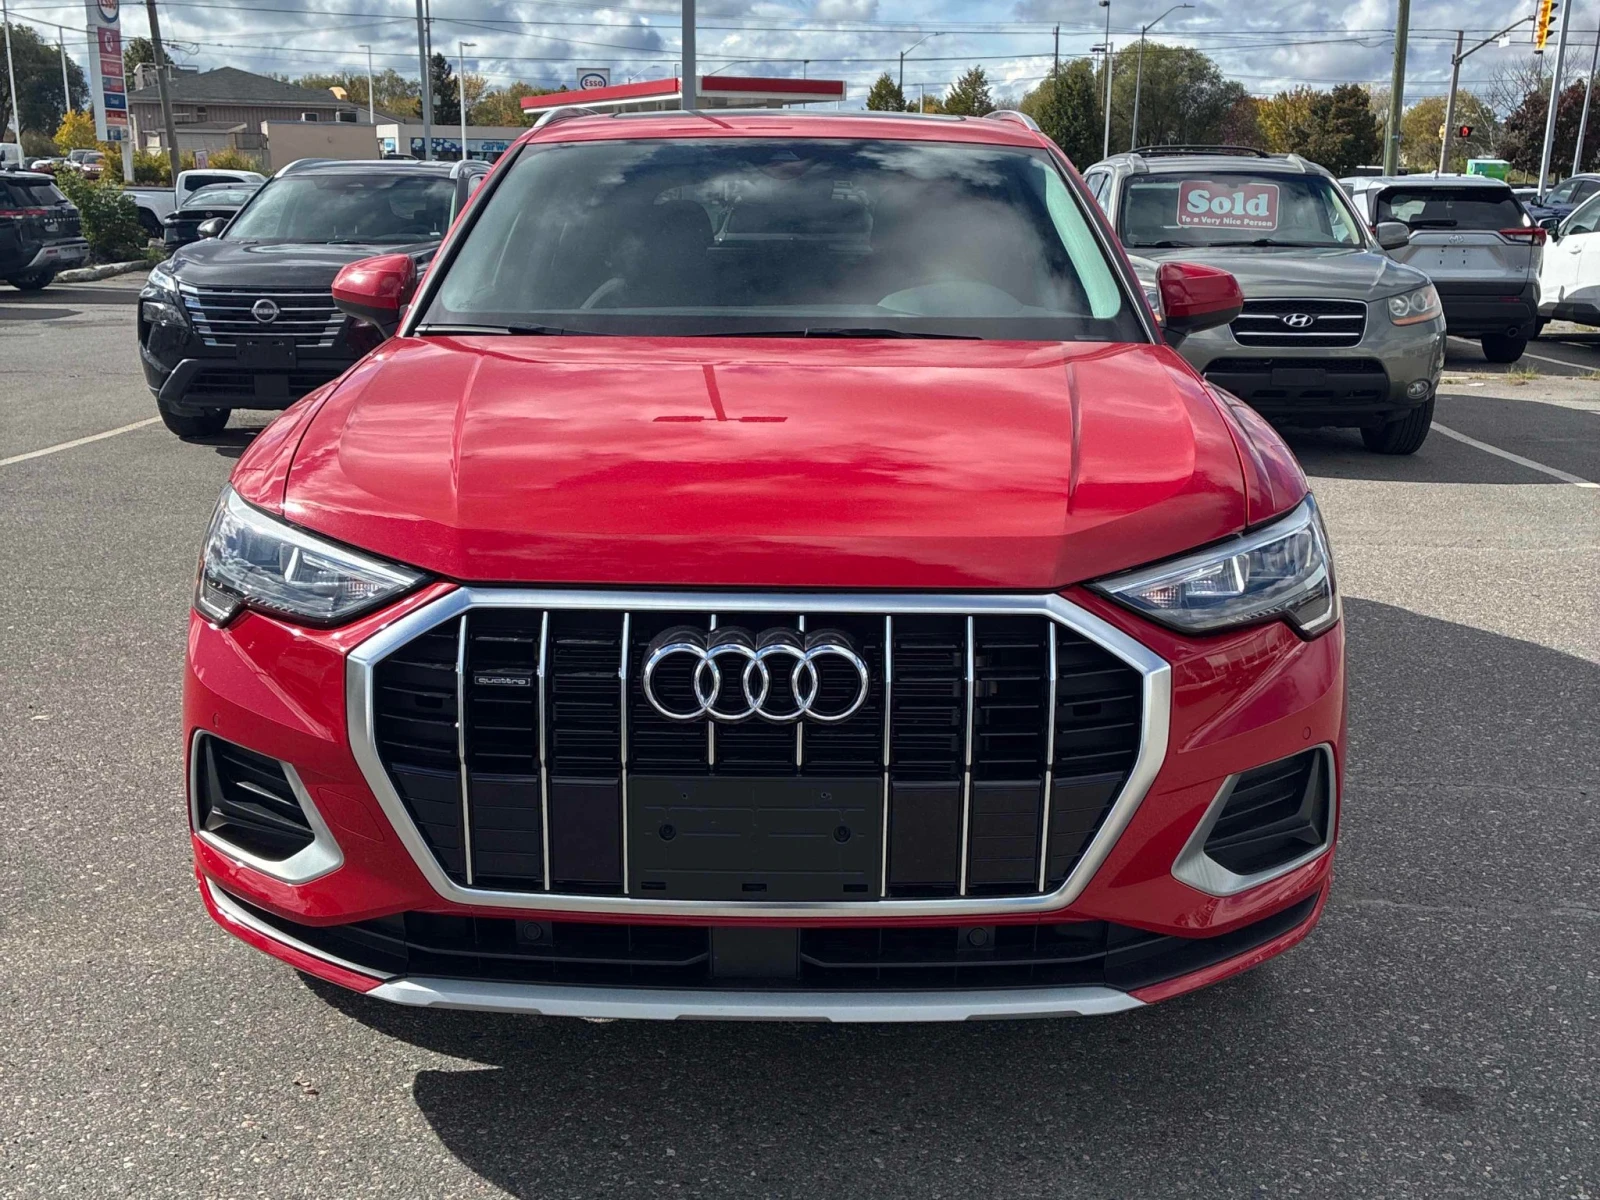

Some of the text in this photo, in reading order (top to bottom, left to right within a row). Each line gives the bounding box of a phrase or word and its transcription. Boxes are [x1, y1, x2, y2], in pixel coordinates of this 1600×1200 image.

[584, 78, 603, 87] Esso
[1186, 189, 1270, 217] Sold
[1181, 215, 1191, 223] To
[1201, 216, 1221, 225] Very
[1223, 217, 1241, 225] Nice
[1243, 218, 1273, 227] Person
[478, 677, 526, 685] quattro
